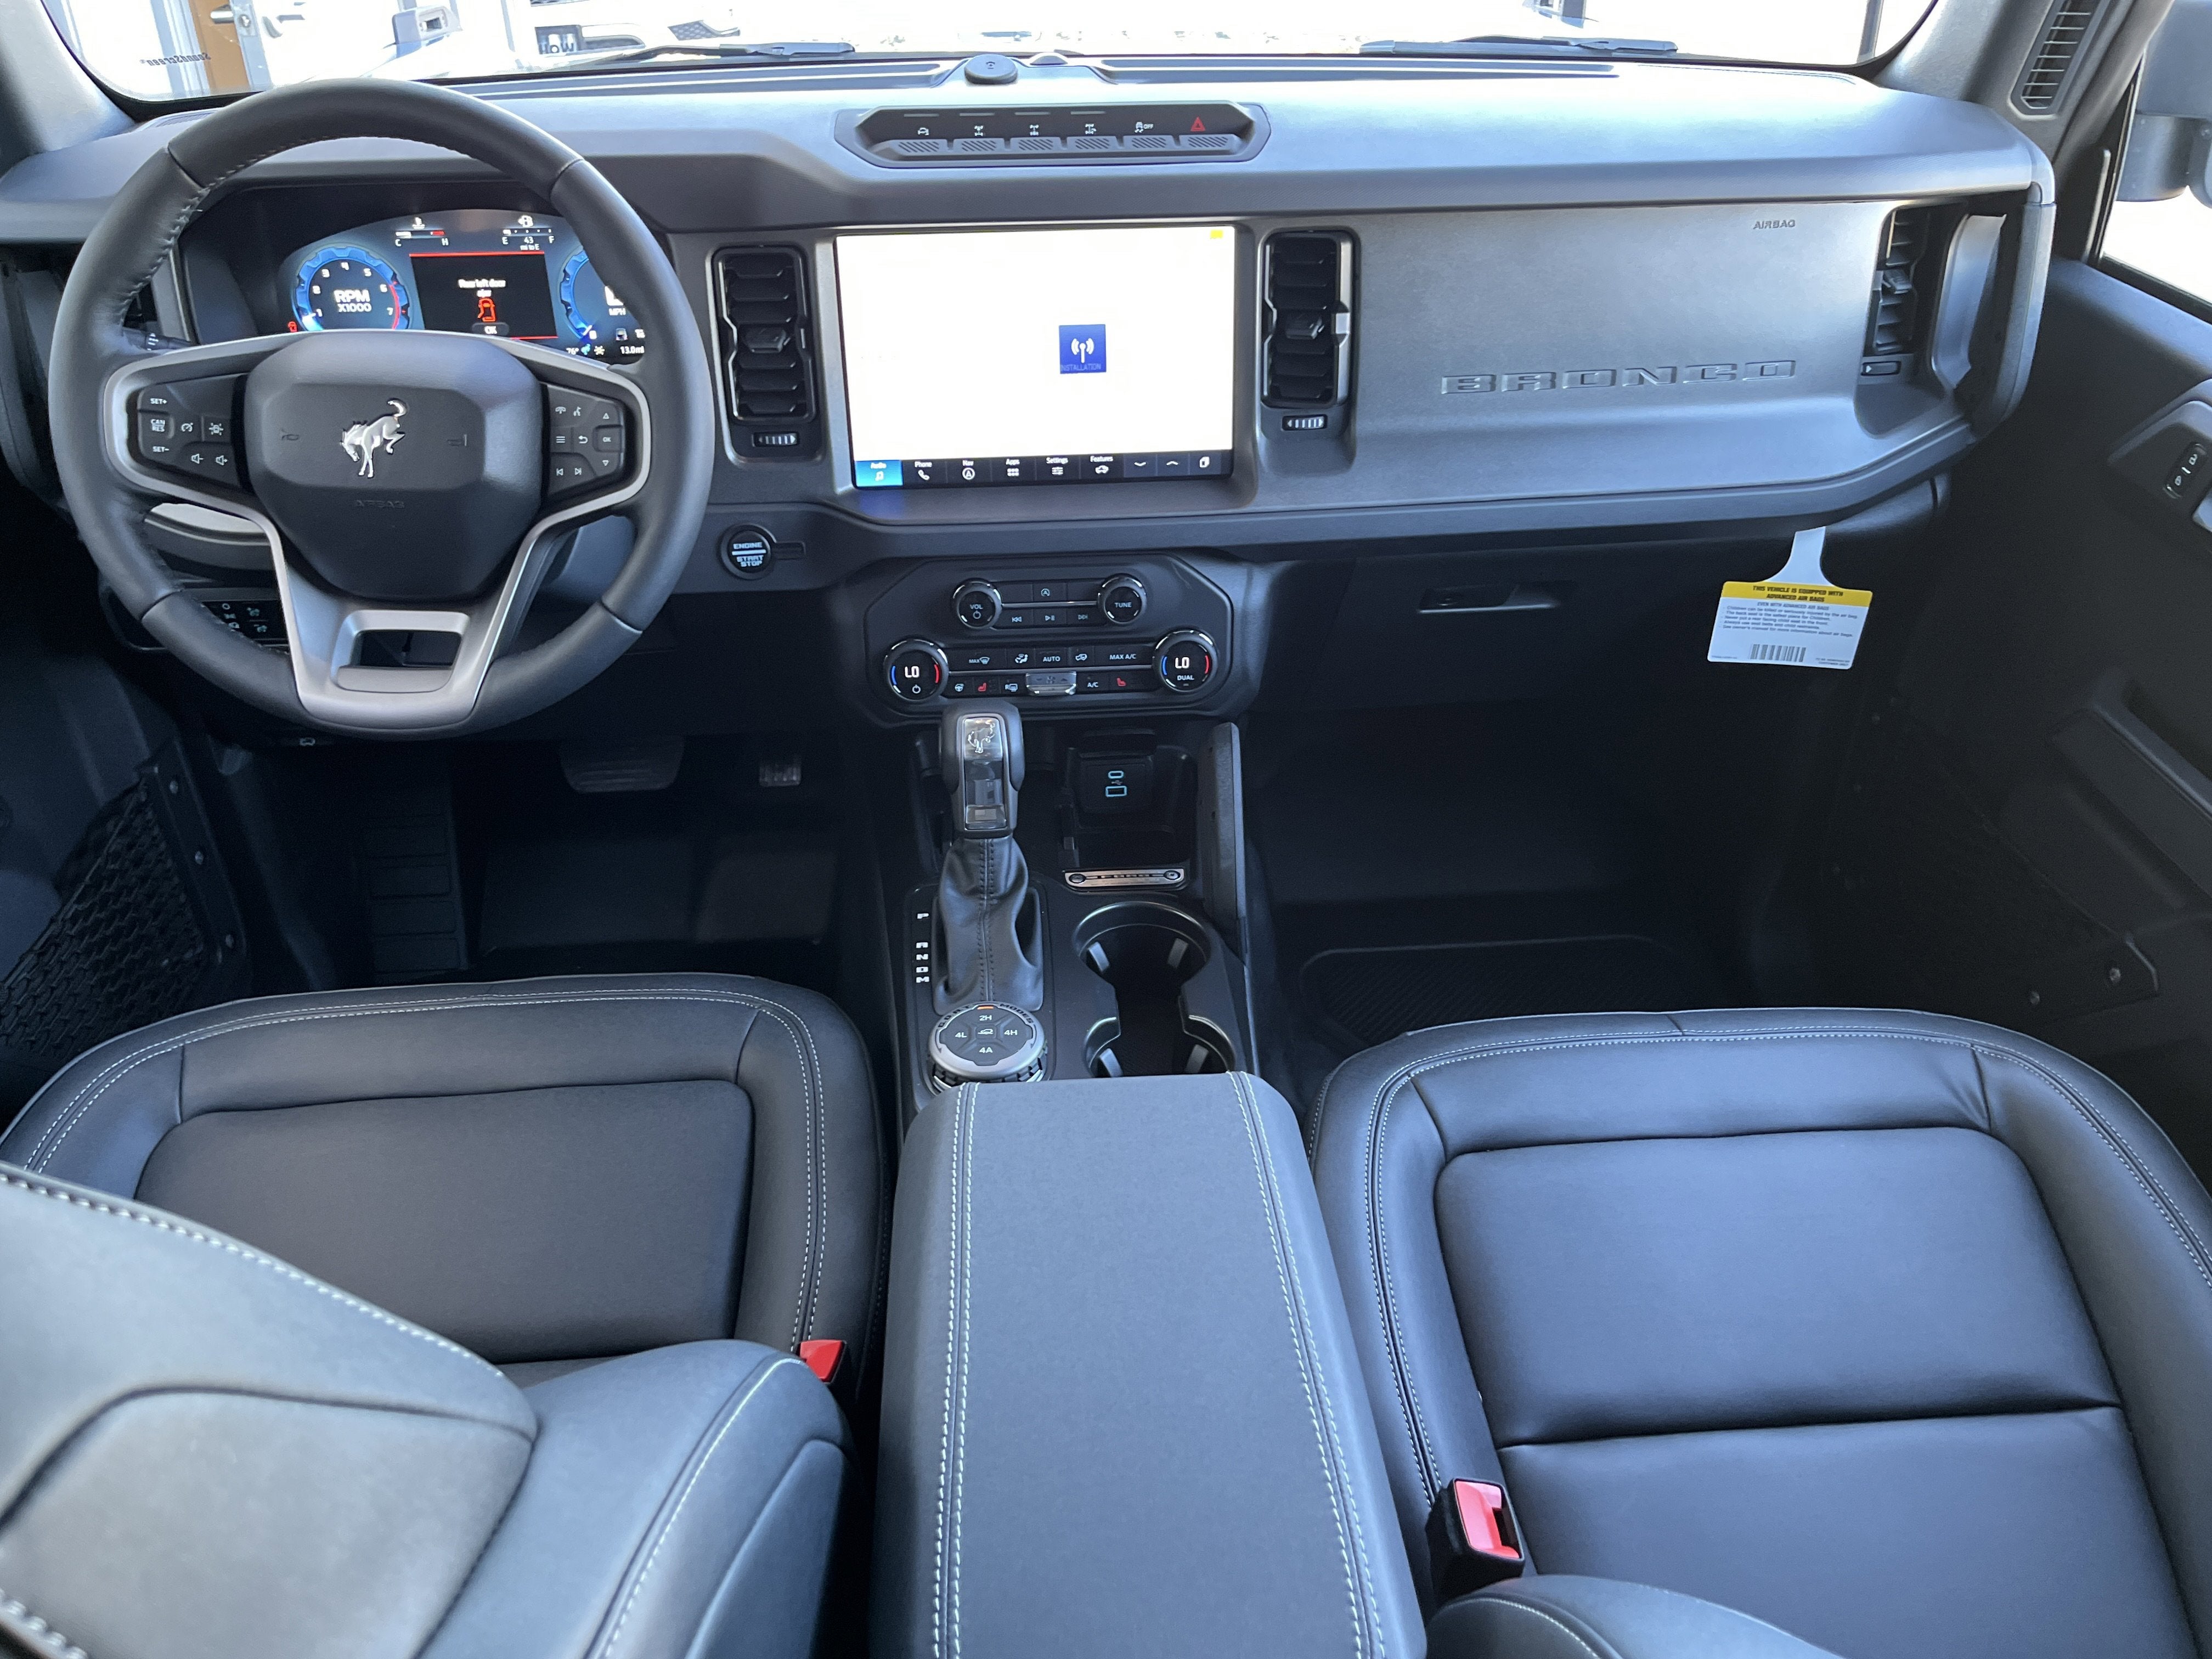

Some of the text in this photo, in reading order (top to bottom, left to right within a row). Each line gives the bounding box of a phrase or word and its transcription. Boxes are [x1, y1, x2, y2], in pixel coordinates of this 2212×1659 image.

[1753, 219, 1795, 229] AIRBAG
[395, 238, 402, 246] C
[502, 236, 508, 245] E
[549, 235, 554, 244] F
[341, 262, 349, 270] 4
[321, 269, 330, 278] 3
[364, 268, 371, 276] 5
[312, 285, 320, 294] 2
[380, 284, 387, 292] 6
[334, 289, 370, 302] RPM
[337, 303, 372, 312] X1000
[387, 307, 393, 315] 7
[317, 308, 323, 317] 1
[484, 326, 497, 334] OK
[1441, 360, 1796, 395] BRONCO
[1175, 657, 1189, 669] LO
[905, 665, 919, 678] LO
[1000, 1003, 1034, 1024] MODES
